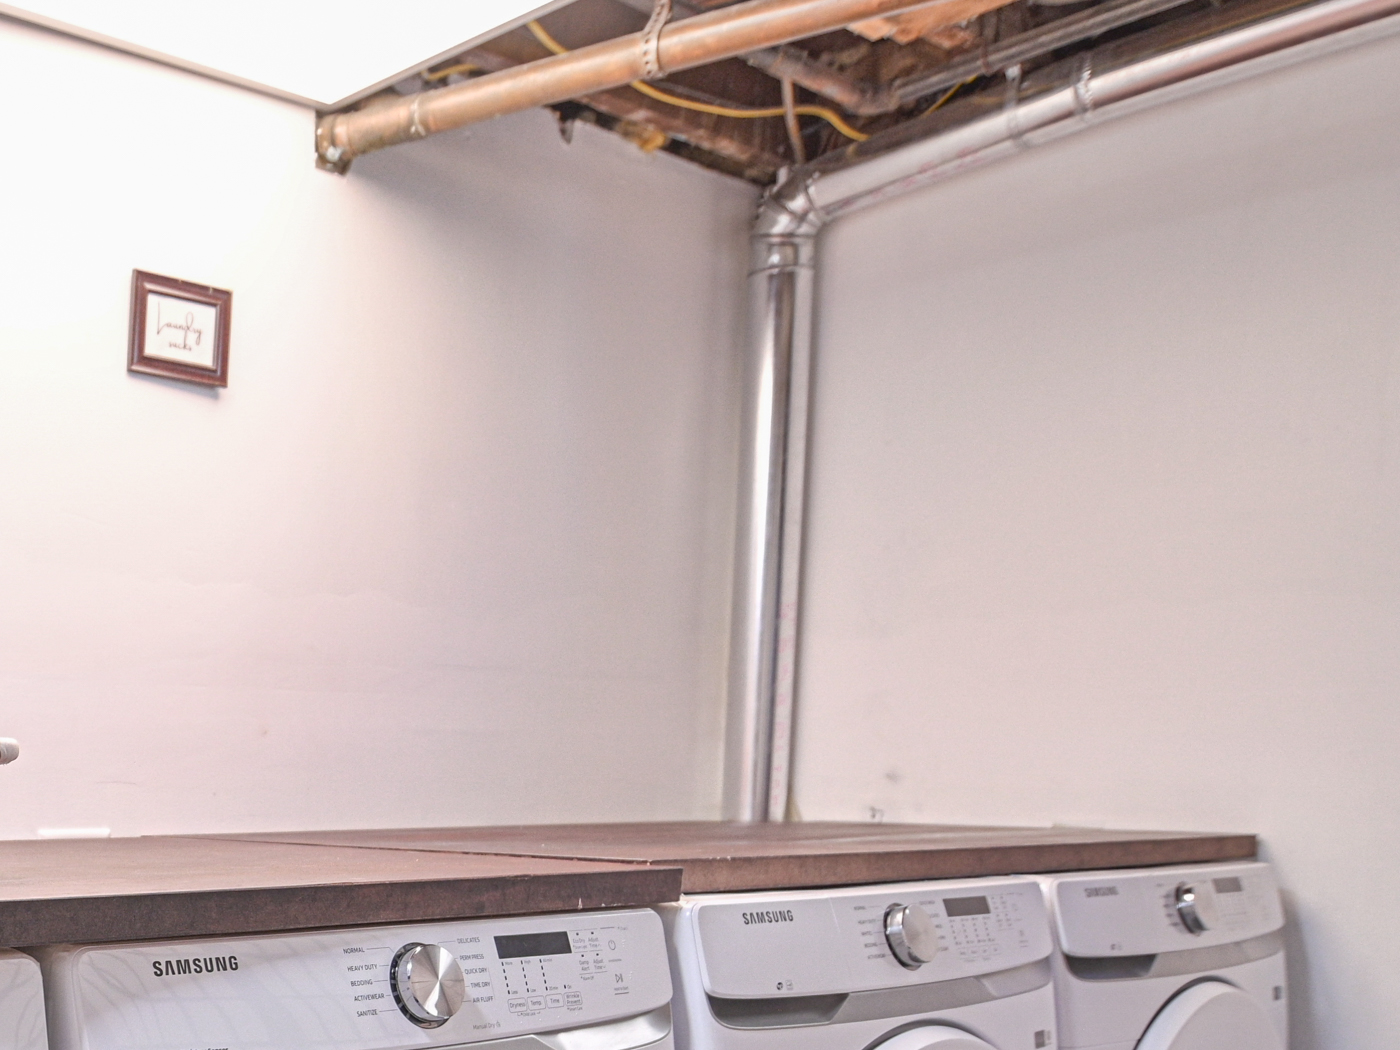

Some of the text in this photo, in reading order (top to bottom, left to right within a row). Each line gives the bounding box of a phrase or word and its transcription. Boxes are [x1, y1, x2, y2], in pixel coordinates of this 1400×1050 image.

[156, 300, 203, 346] Laundry
[742, 909, 794, 926] SAMSUNG
[152, 955, 239, 977] SAMSUNG
[350, 979, 374, 987] BEDDING
[354, 992, 385, 1002] ACTIVEWEAR
[357, 1008, 378, 1017] SANITIZE
[472, 1021, 496, 1030] Manual Dry
